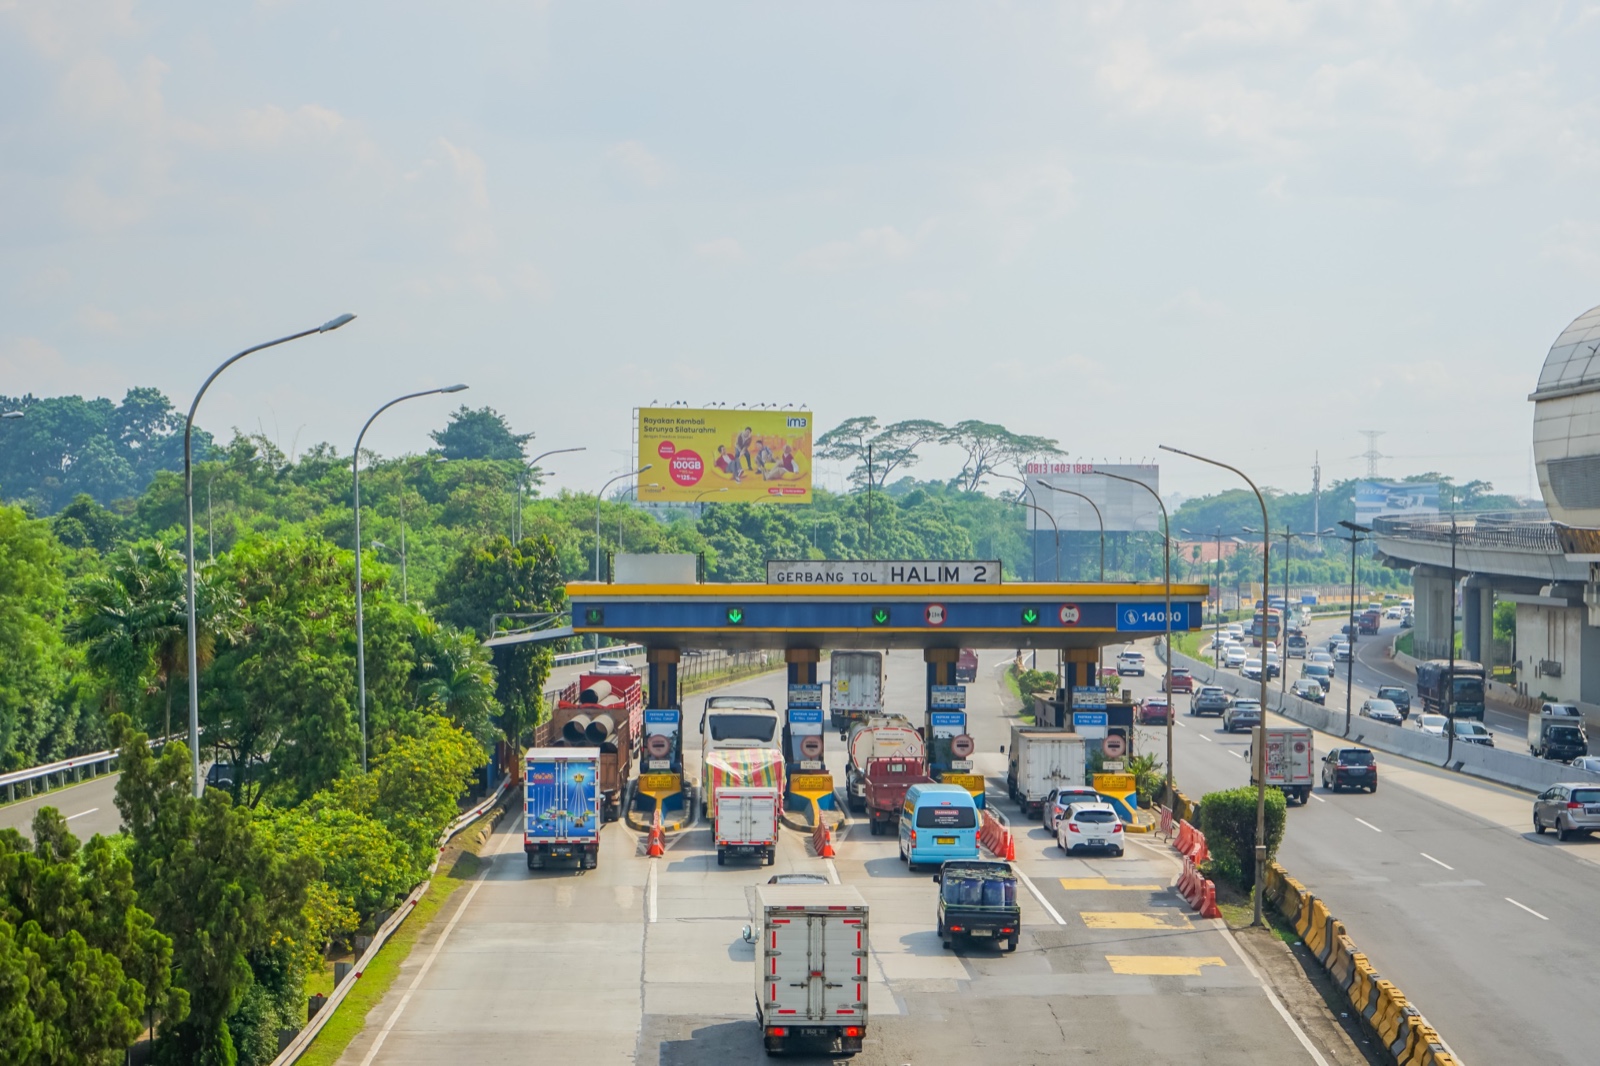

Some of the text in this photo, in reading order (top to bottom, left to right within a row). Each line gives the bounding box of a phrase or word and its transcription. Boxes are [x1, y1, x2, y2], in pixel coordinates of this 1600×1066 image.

[643, 417, 705, 425] Rayakan Kembali
[643, 426, 717, 434] Serunya Silaturahmi
[673, 460, 701, 470] 100GB
[1027, 463, 1048, 474] 0813
[777, 566, 987, 583] GERBANG TOL HALIM 2
